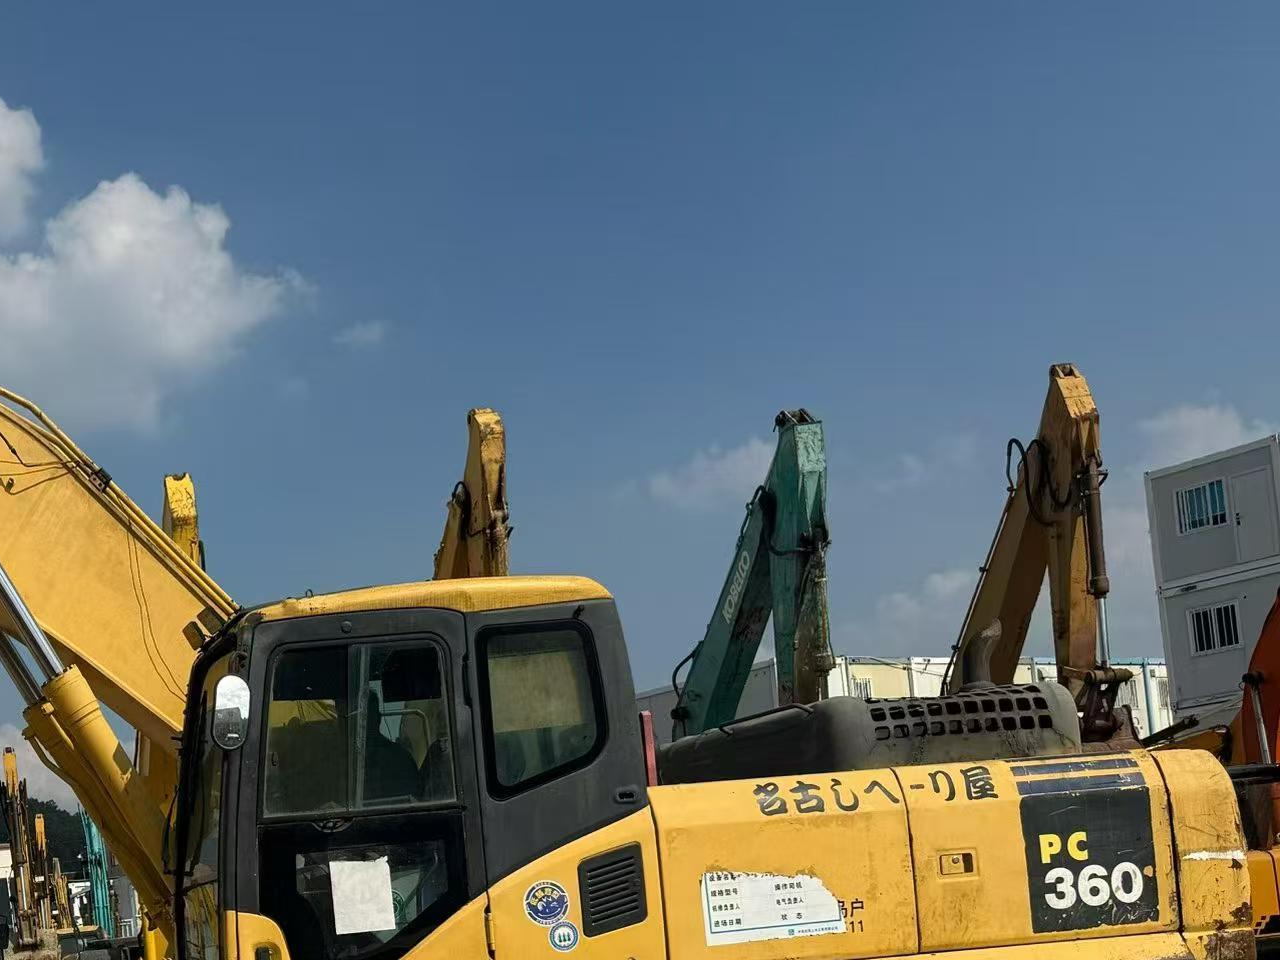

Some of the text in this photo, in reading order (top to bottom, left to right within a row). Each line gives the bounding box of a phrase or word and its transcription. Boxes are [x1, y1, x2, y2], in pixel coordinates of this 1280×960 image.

[722, 551, 750, 624] KOBELCO
[1039, 831, 1088, 864] PC
[1045, 861, 1144, 909] 360
